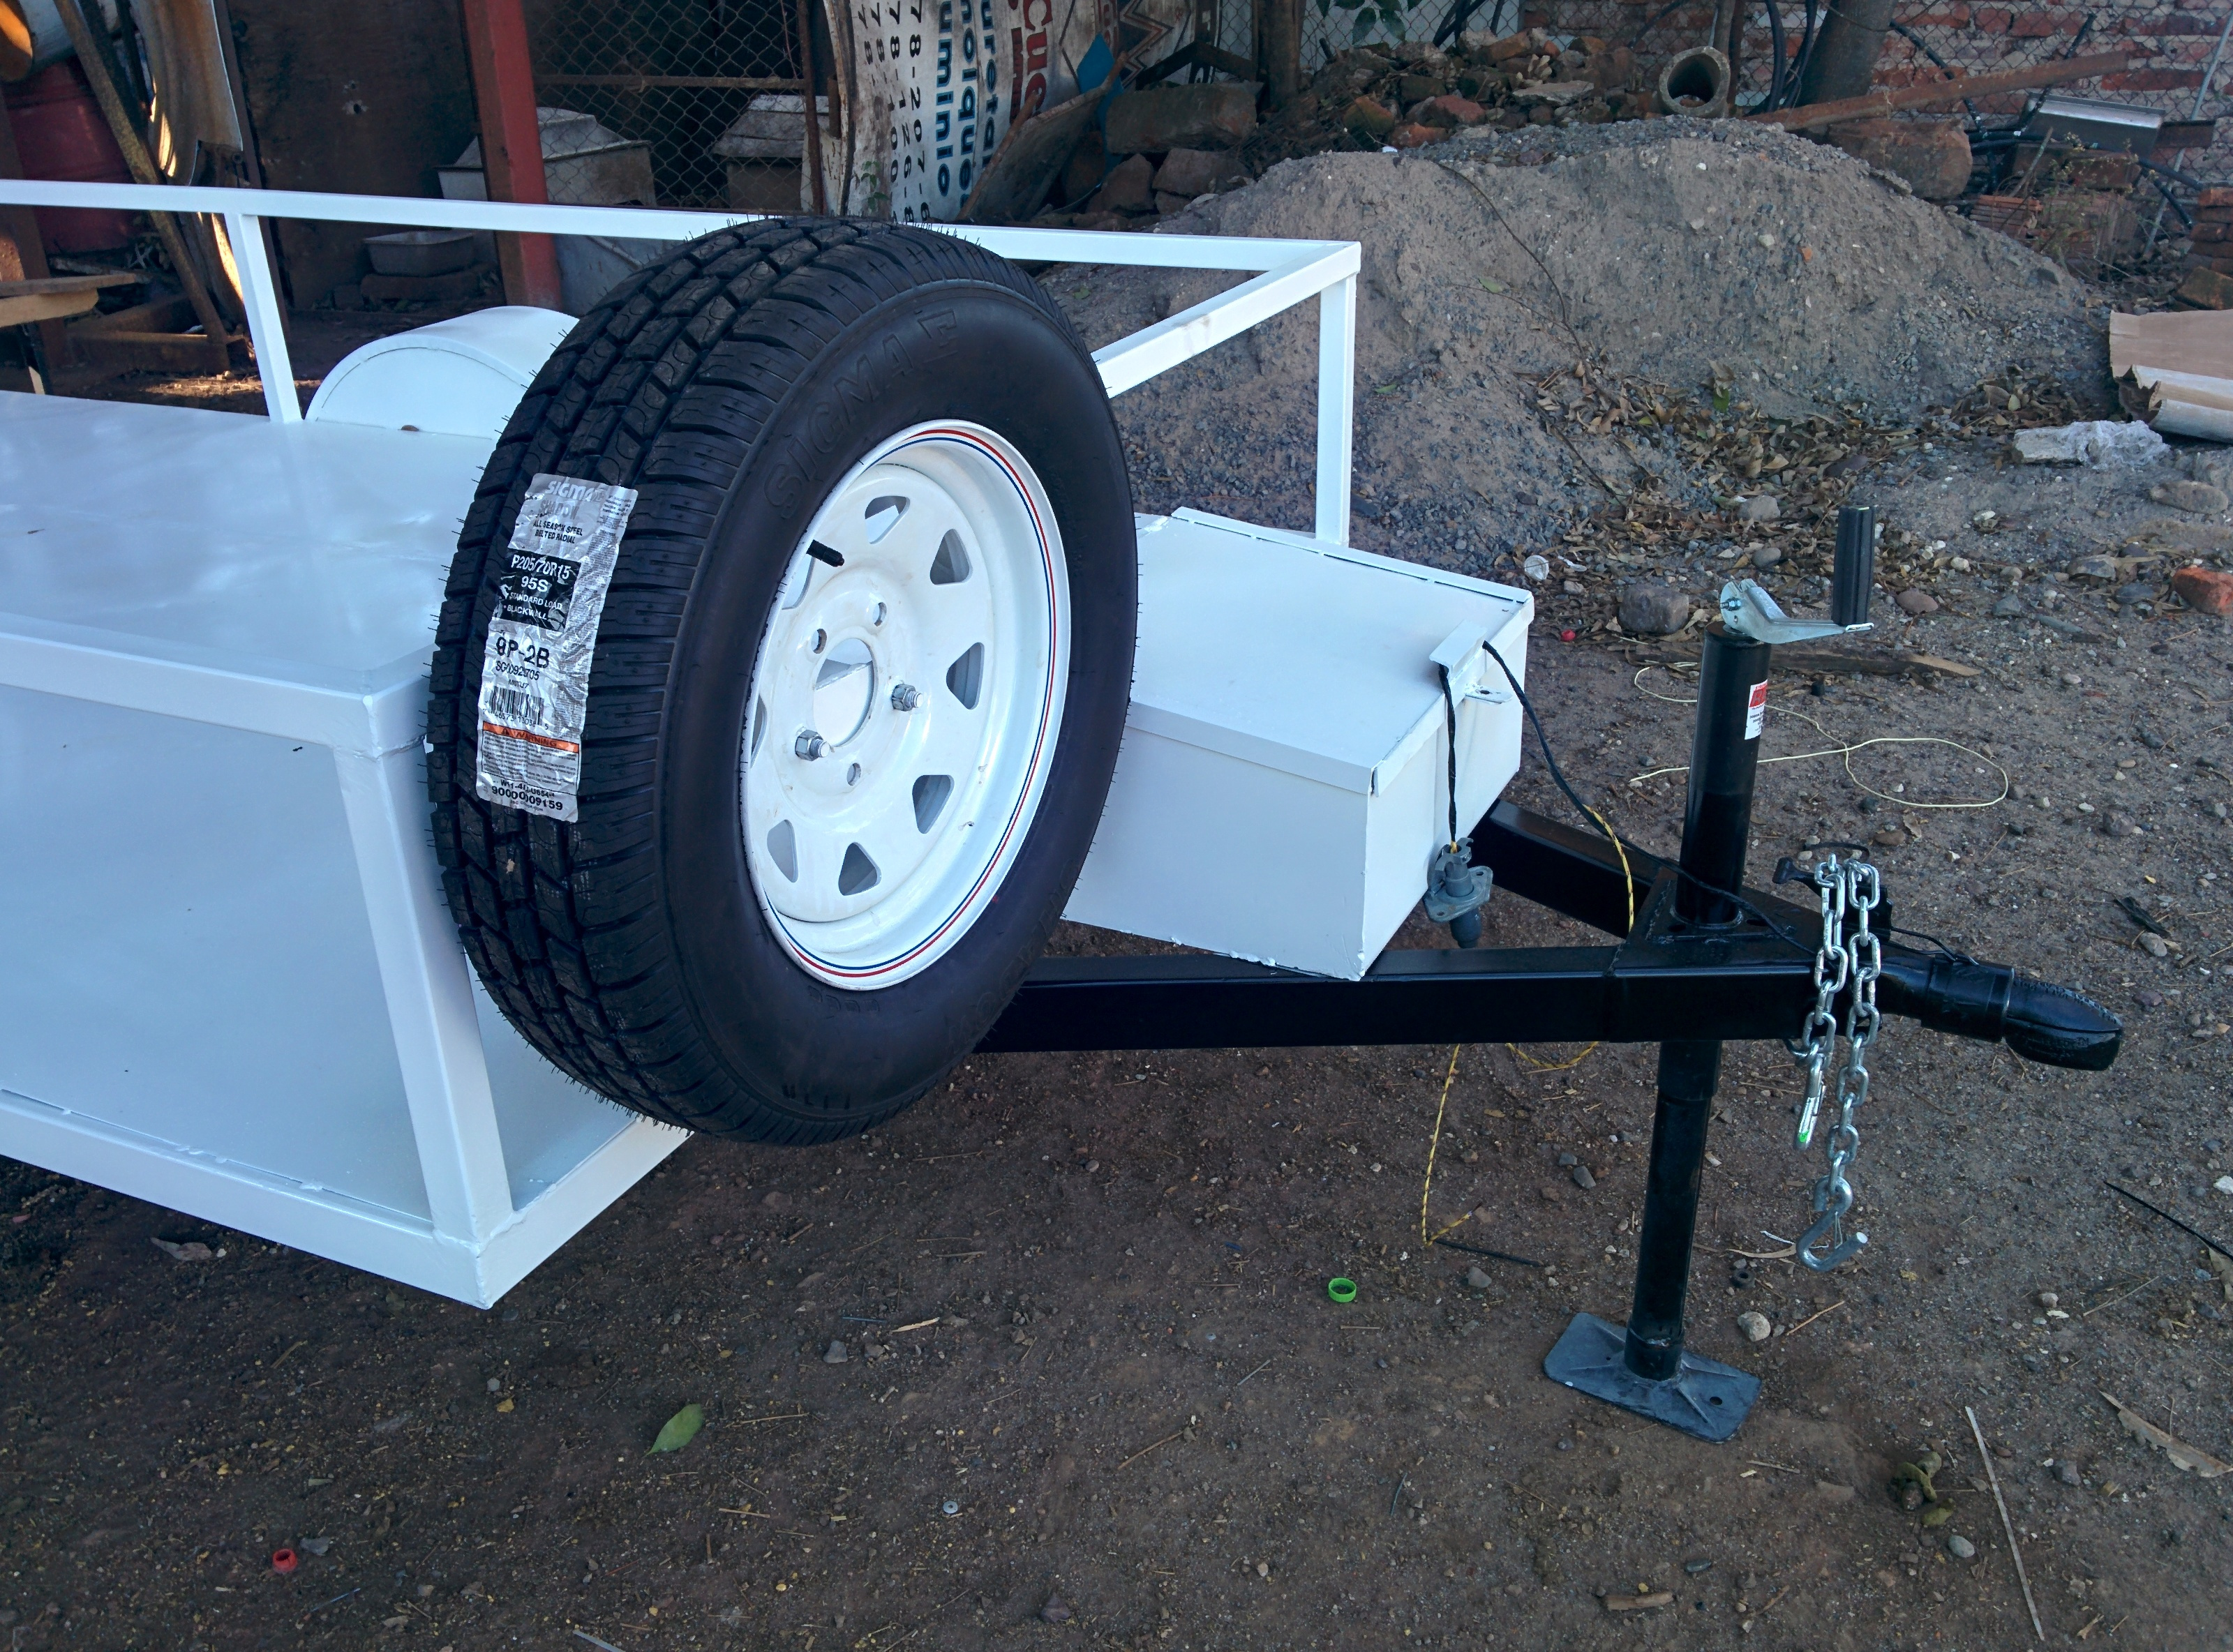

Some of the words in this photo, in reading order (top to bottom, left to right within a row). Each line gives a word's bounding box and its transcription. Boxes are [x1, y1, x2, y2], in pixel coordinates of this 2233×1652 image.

[533, 520, 542, 528] ALL
[511, 554, 572, 580] P205/70R15
[521, 576, 549, 592] 95S
[509, 592, 544, 606] STANDARD
[544, 599, 562, 610] LOAD
